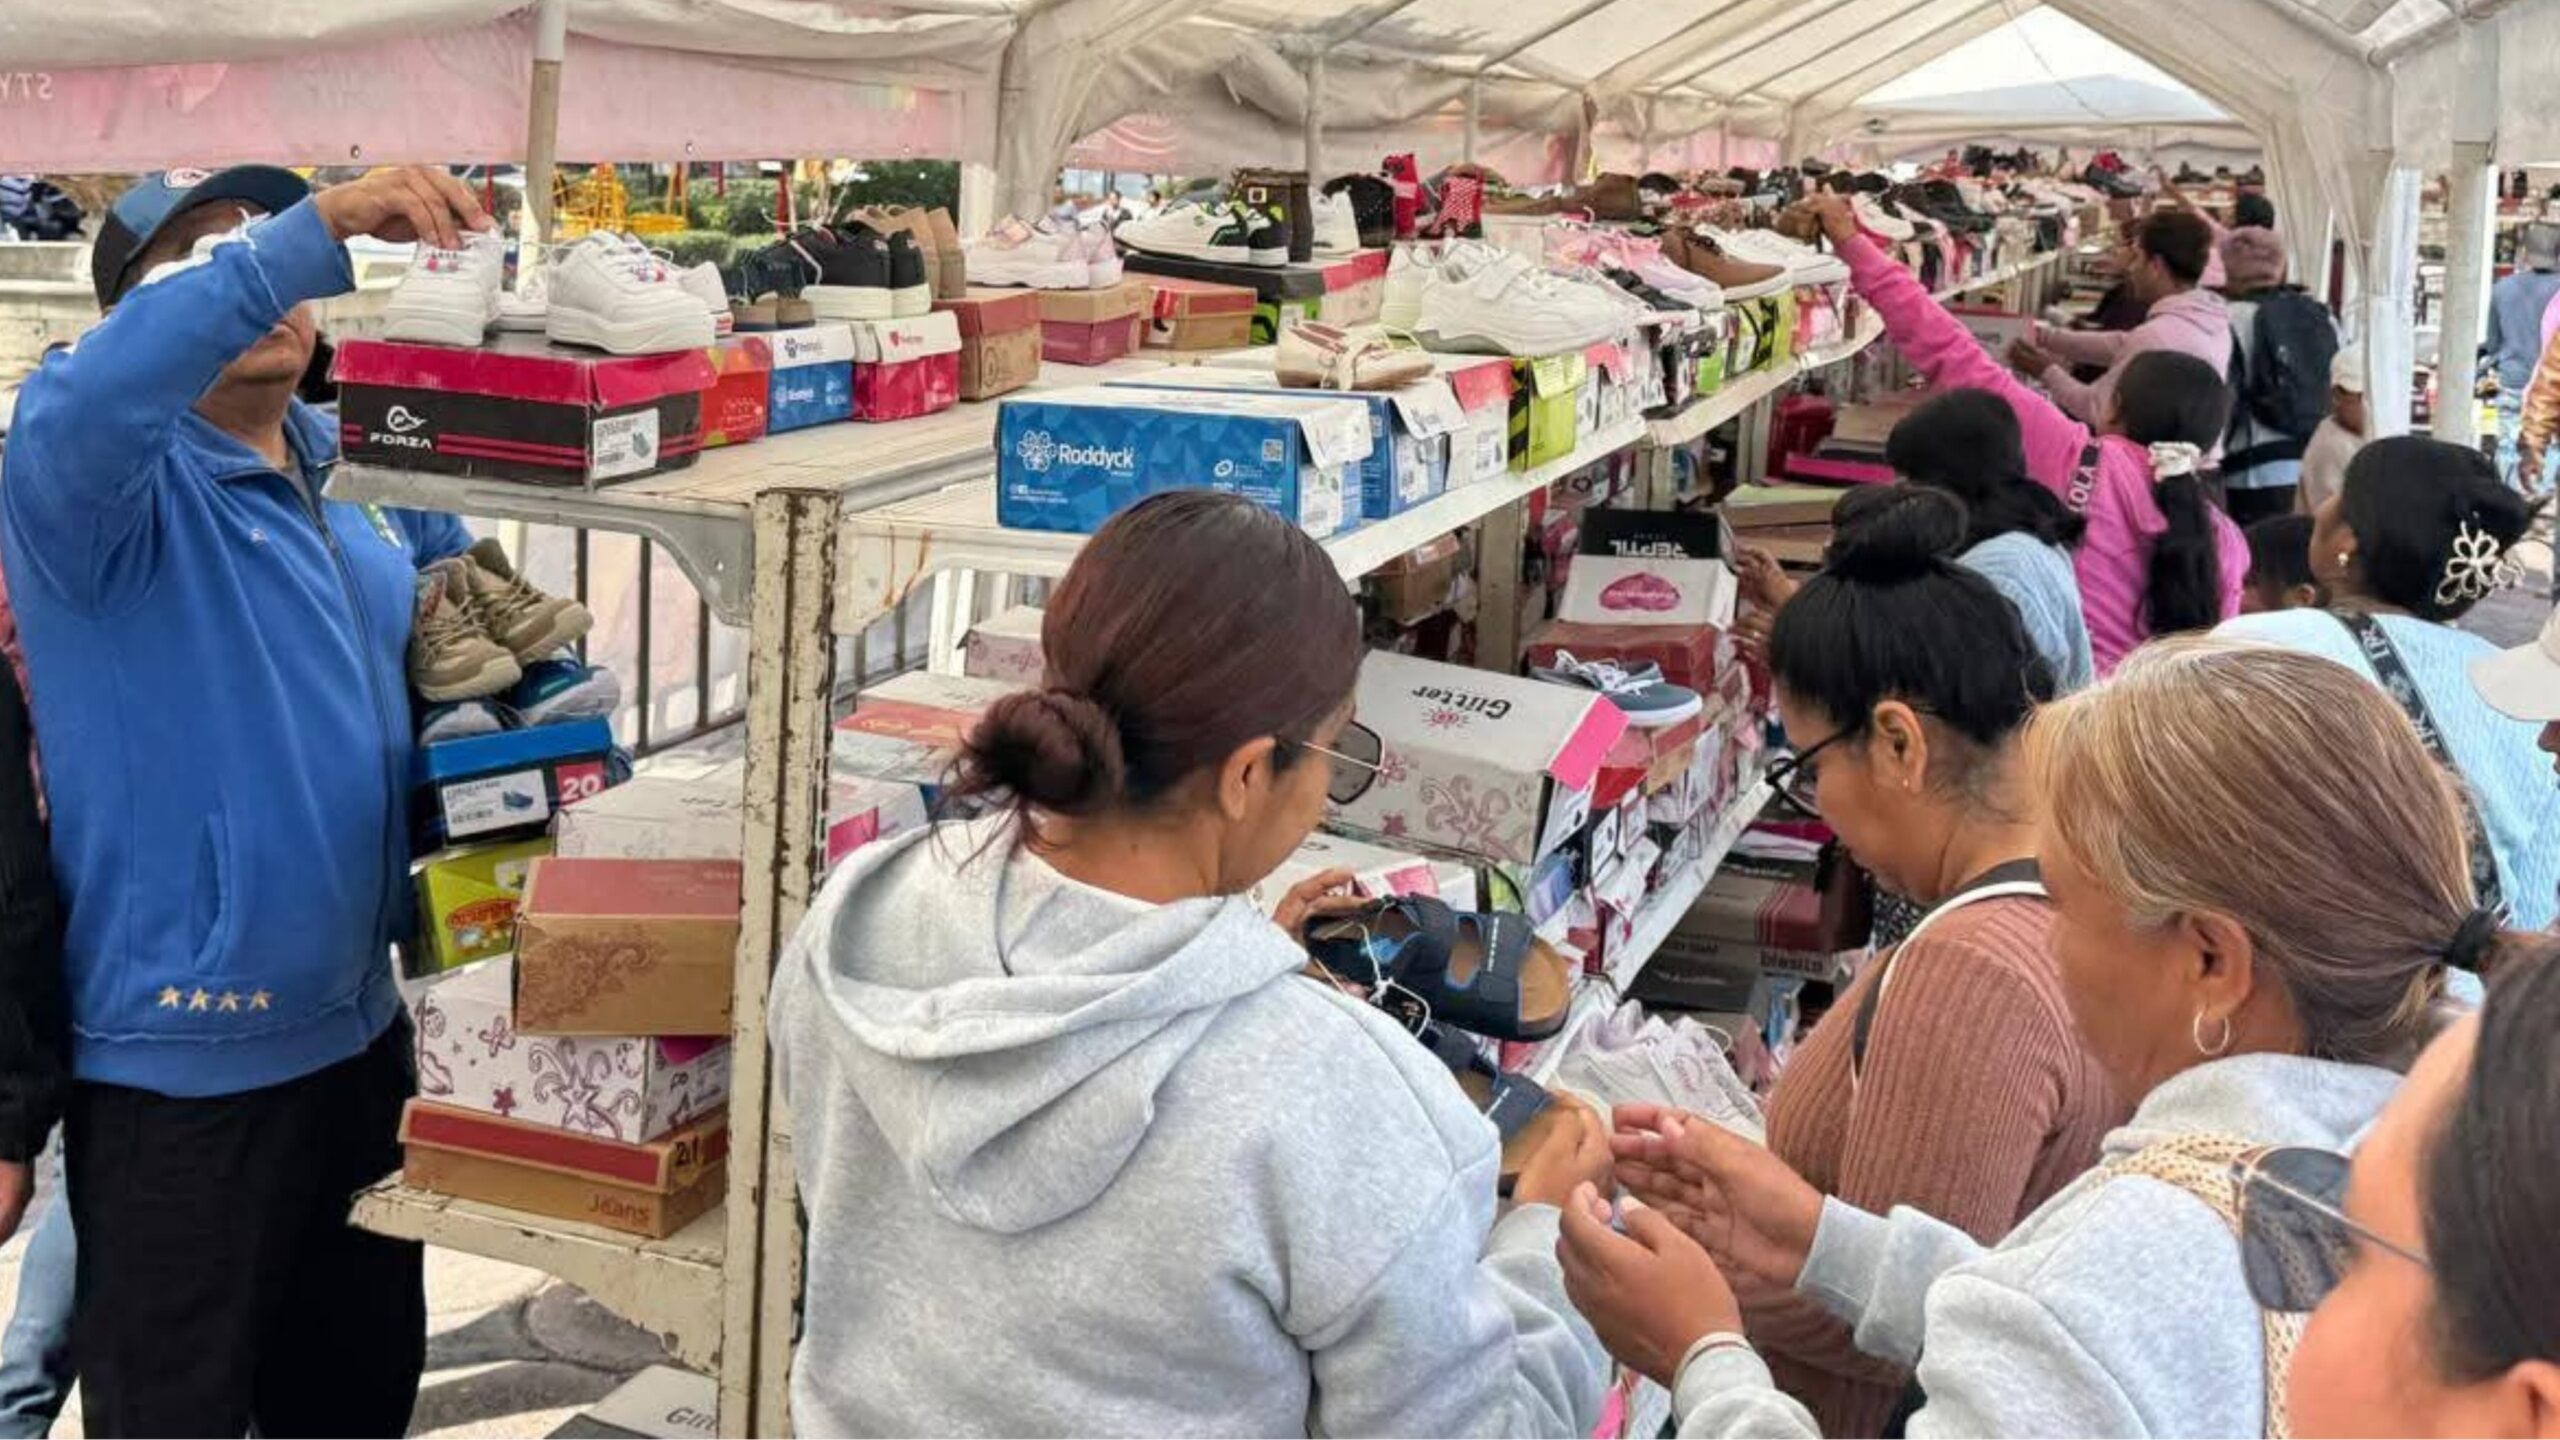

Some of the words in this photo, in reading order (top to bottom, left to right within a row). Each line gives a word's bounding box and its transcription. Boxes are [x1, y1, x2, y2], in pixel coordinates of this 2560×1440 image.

[370, 432, 432, 449] FORZA
[1059, 443, 1135, 470] Roddyck
[1610, 540, 1688, 559] REPTIL
[1412, 686, 1512, 720] Glitter
[562, 774, 601, 801] 20
[588, 1193, 650, 1220] Jeans
